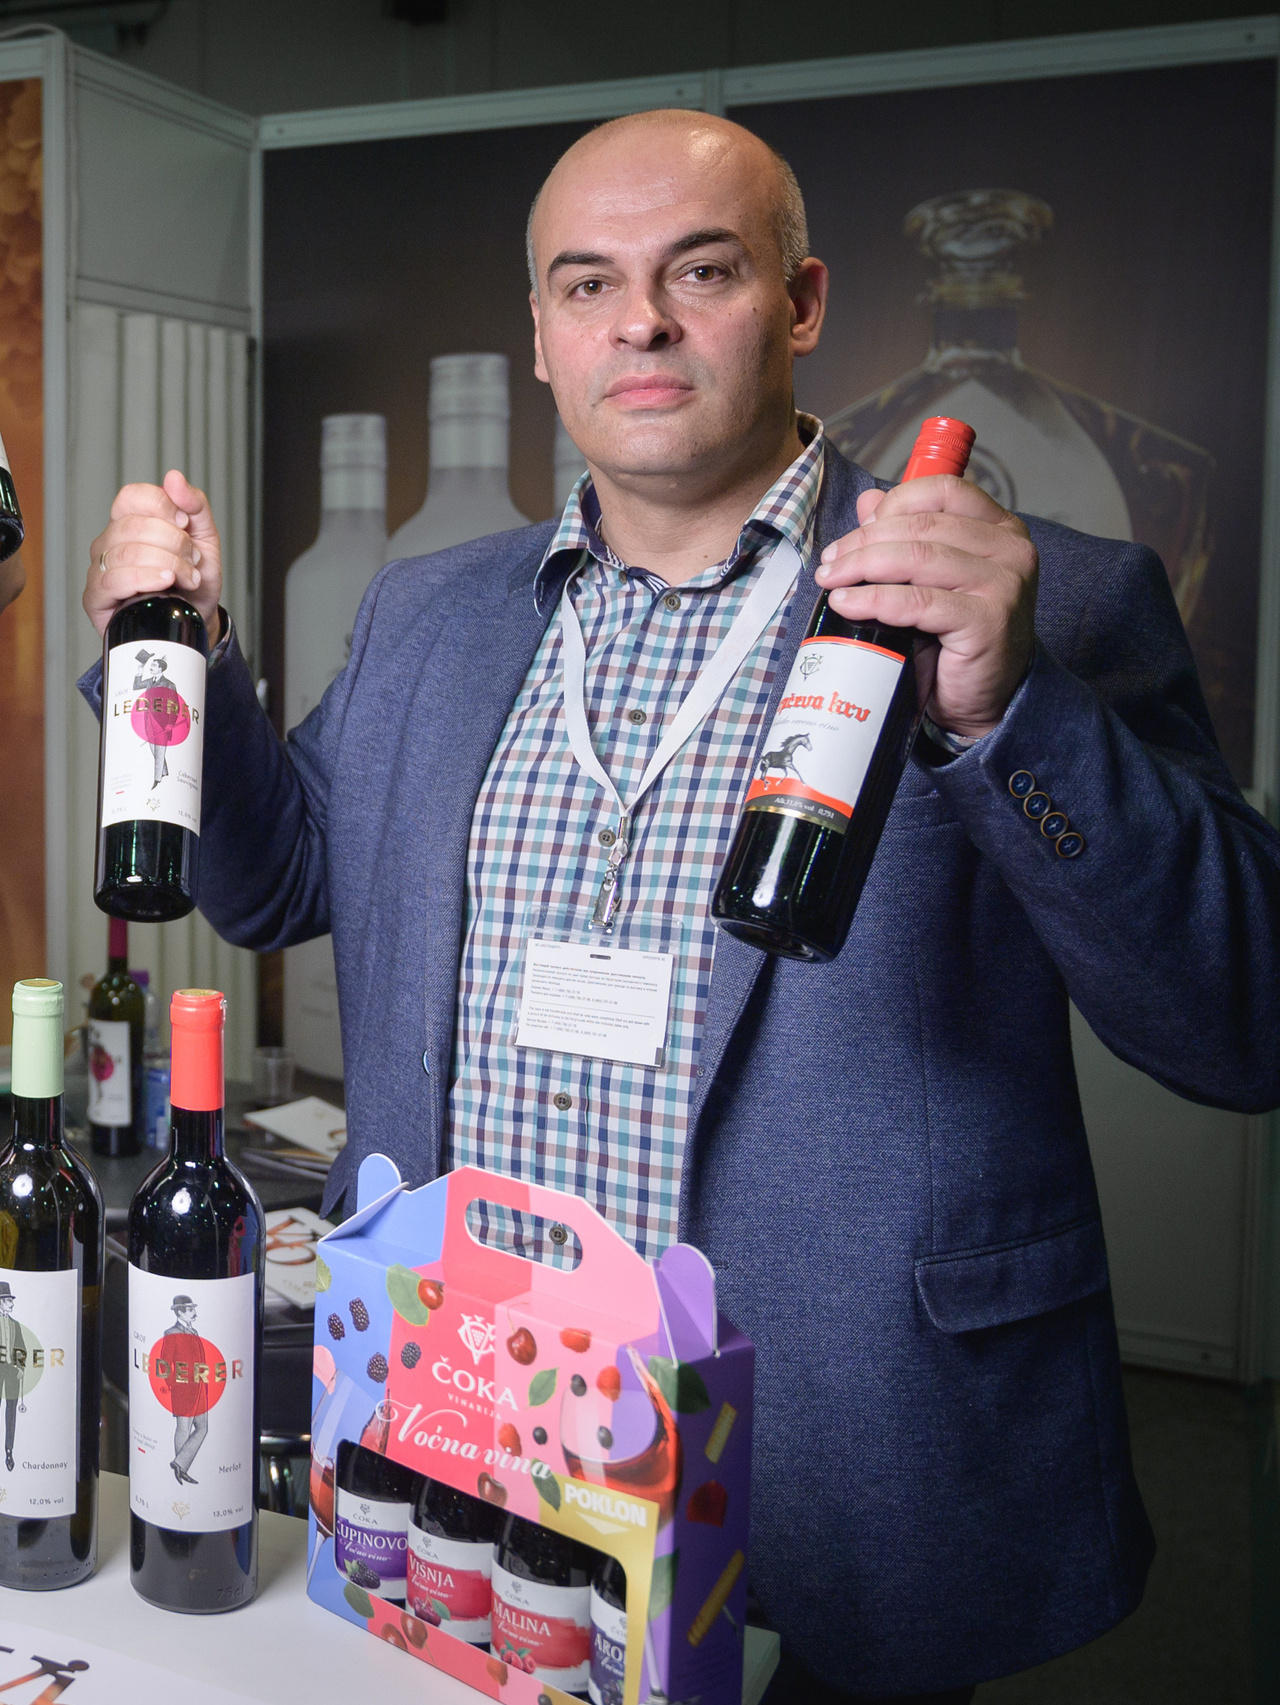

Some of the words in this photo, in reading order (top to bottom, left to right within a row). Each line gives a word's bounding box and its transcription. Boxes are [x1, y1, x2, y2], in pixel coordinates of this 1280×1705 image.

[114, 697, 200, 725] LEDERER
[827, 690, 871, 722] krv
[134, 1348, 244, 1384] LEDERER
[431, 1355, 519, 1412] ČOKA
[448, 1393, 502, 1421] VINARIJA
[22, 1461, 68, 1470] Chardonnay
[219, 1462, 242, 1474] Merlot
[483, 1446, 552, 1480] vina
[564, 1483, 648, 1527] POKLON
[408, 1554, 455, 1588] VIŠNJA
[493, 1598, 551, 1637] MALINA
